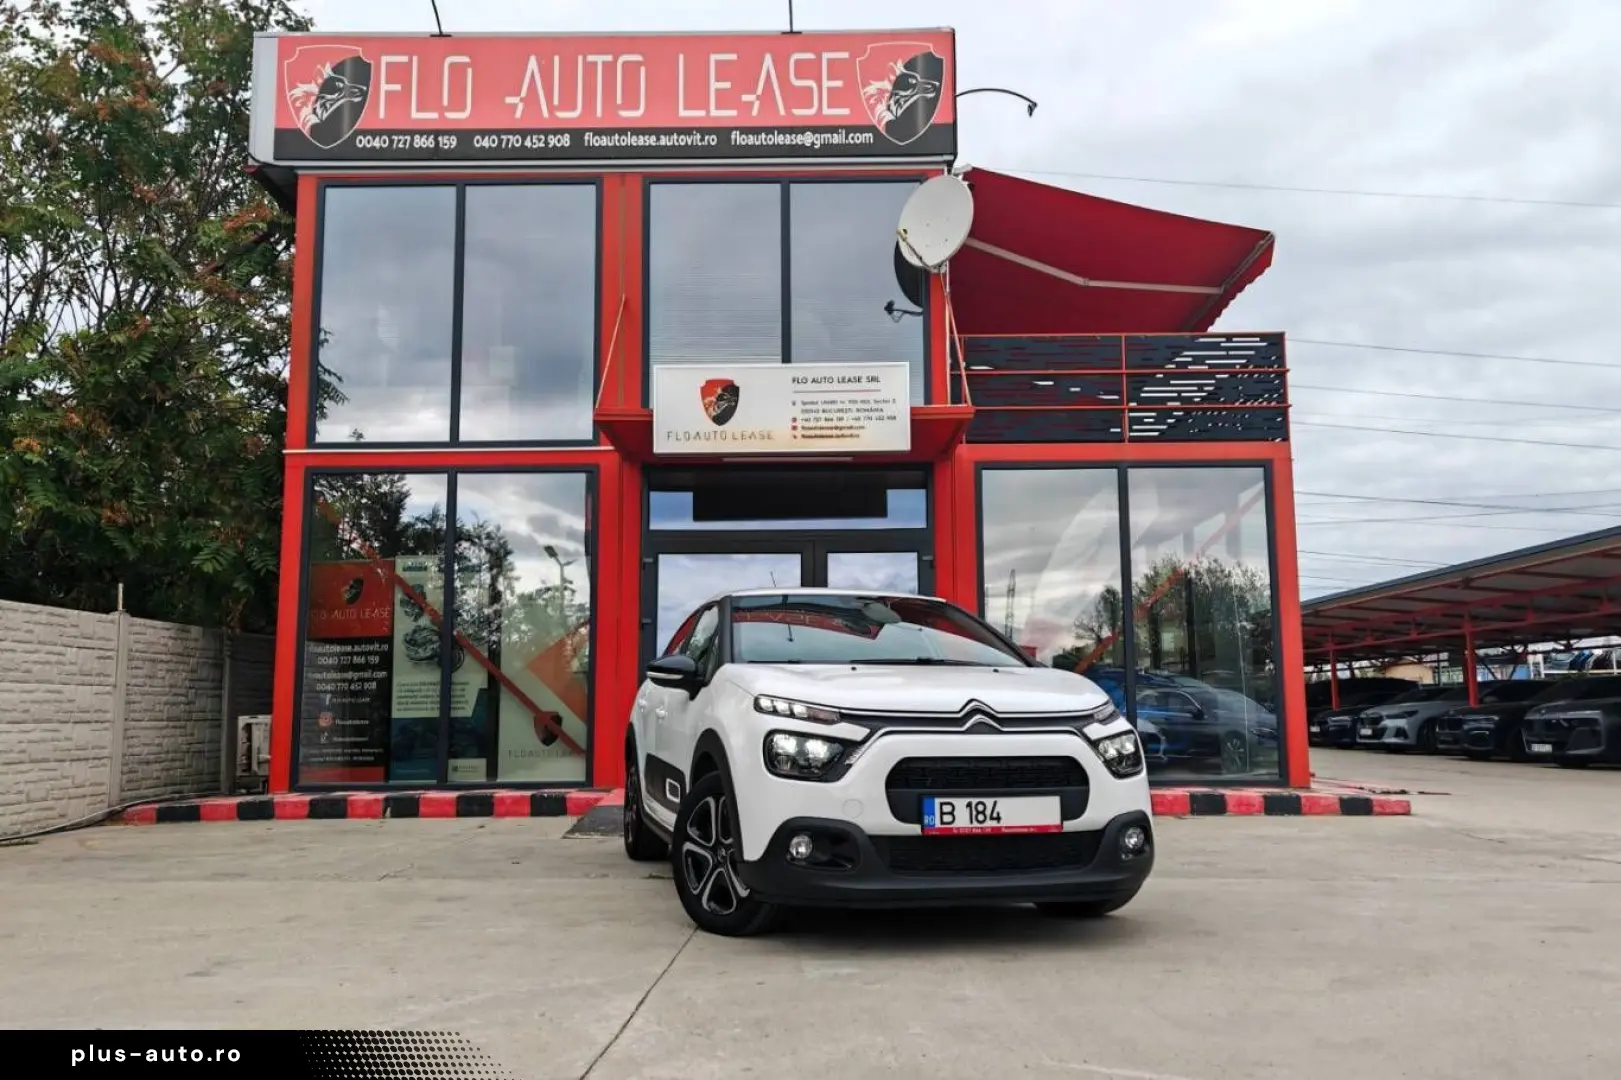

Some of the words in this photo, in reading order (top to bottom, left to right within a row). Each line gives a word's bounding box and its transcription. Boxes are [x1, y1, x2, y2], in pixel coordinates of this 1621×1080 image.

[379, 55, 472, 119] FLO
[505, 53, 645, 119] AUTO
[678, 51, 850, 118] LEASE
[356, 135, 389, 148] 0040
[392, 135, 412, 149] 727
[413, 135, 435, 148] 866
[438, 135, 457, 148] 159
[473, 134, 498, 148] 040
[500, 133, 522, 148] 770
[524, 133, 546, 147] 452
[547, 133, 571, 147] 908
[584, 131, 718, 147] floautolease.autovit.ro
[731, 130, 874, 149] floautolease@gmail.com
[792, 376, 808, 384] FLO
[811, 376, 834, 384] AUTO
[866, 375, 881, 383] SRL
[331, 608, 357, 620] AUTO
[360, 607, 391, 619] LEASE
[924, 815, 935, 825] RO
[939, 801, 956, 825] B
[965, 800, 1002, 825] 184
